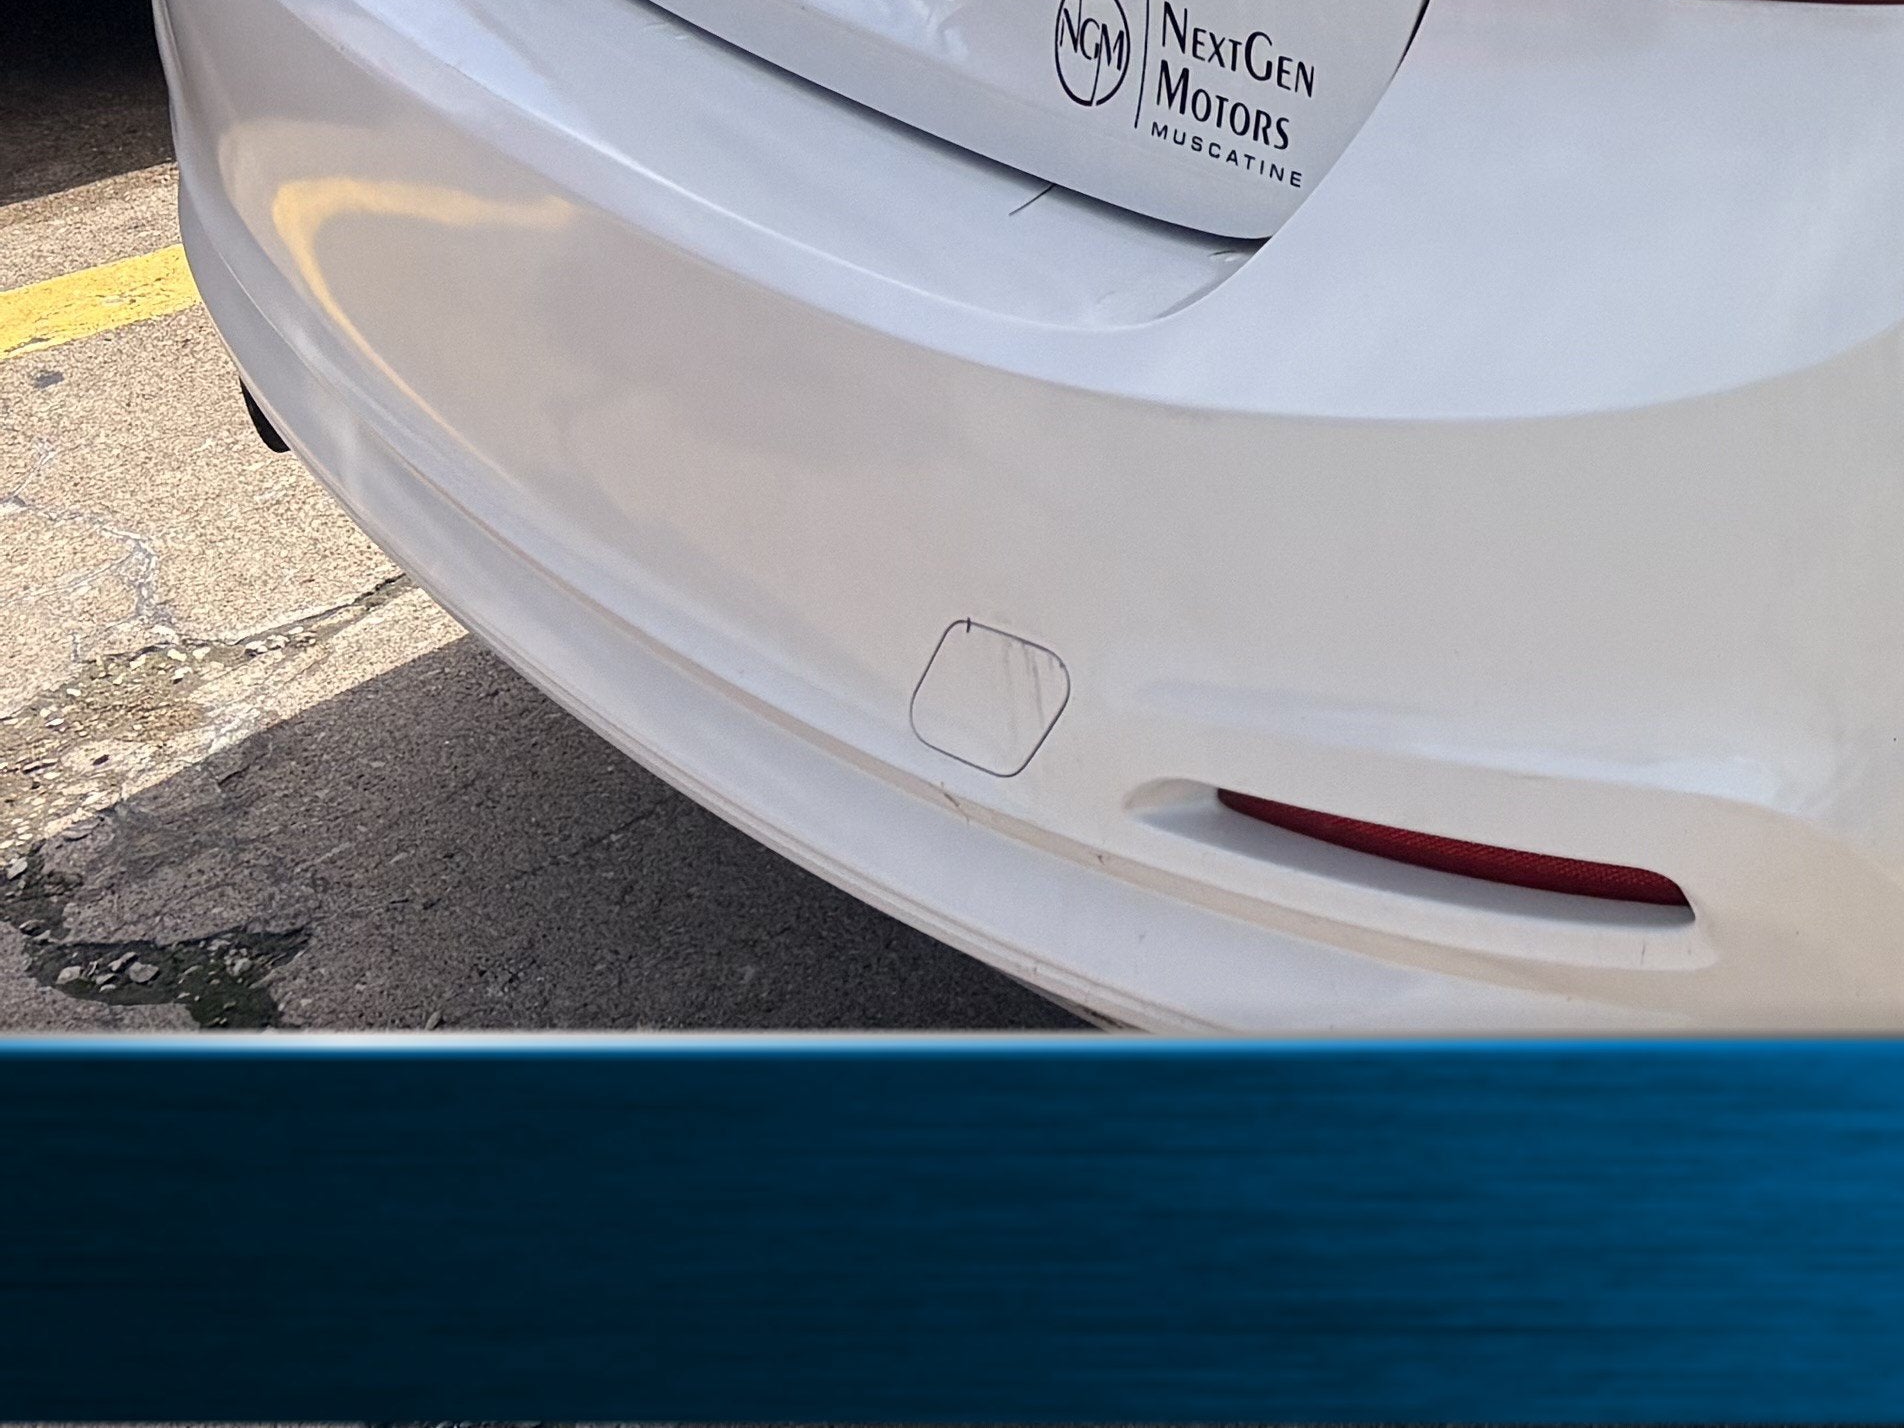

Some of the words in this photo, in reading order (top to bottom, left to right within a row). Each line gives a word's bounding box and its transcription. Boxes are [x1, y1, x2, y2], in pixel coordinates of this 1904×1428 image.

[1060, 7, 1125, 71] NGM
[1156, 58, 1290, 150] MOTORS
[1151, 120, 1303, 188] MUSCATINE
